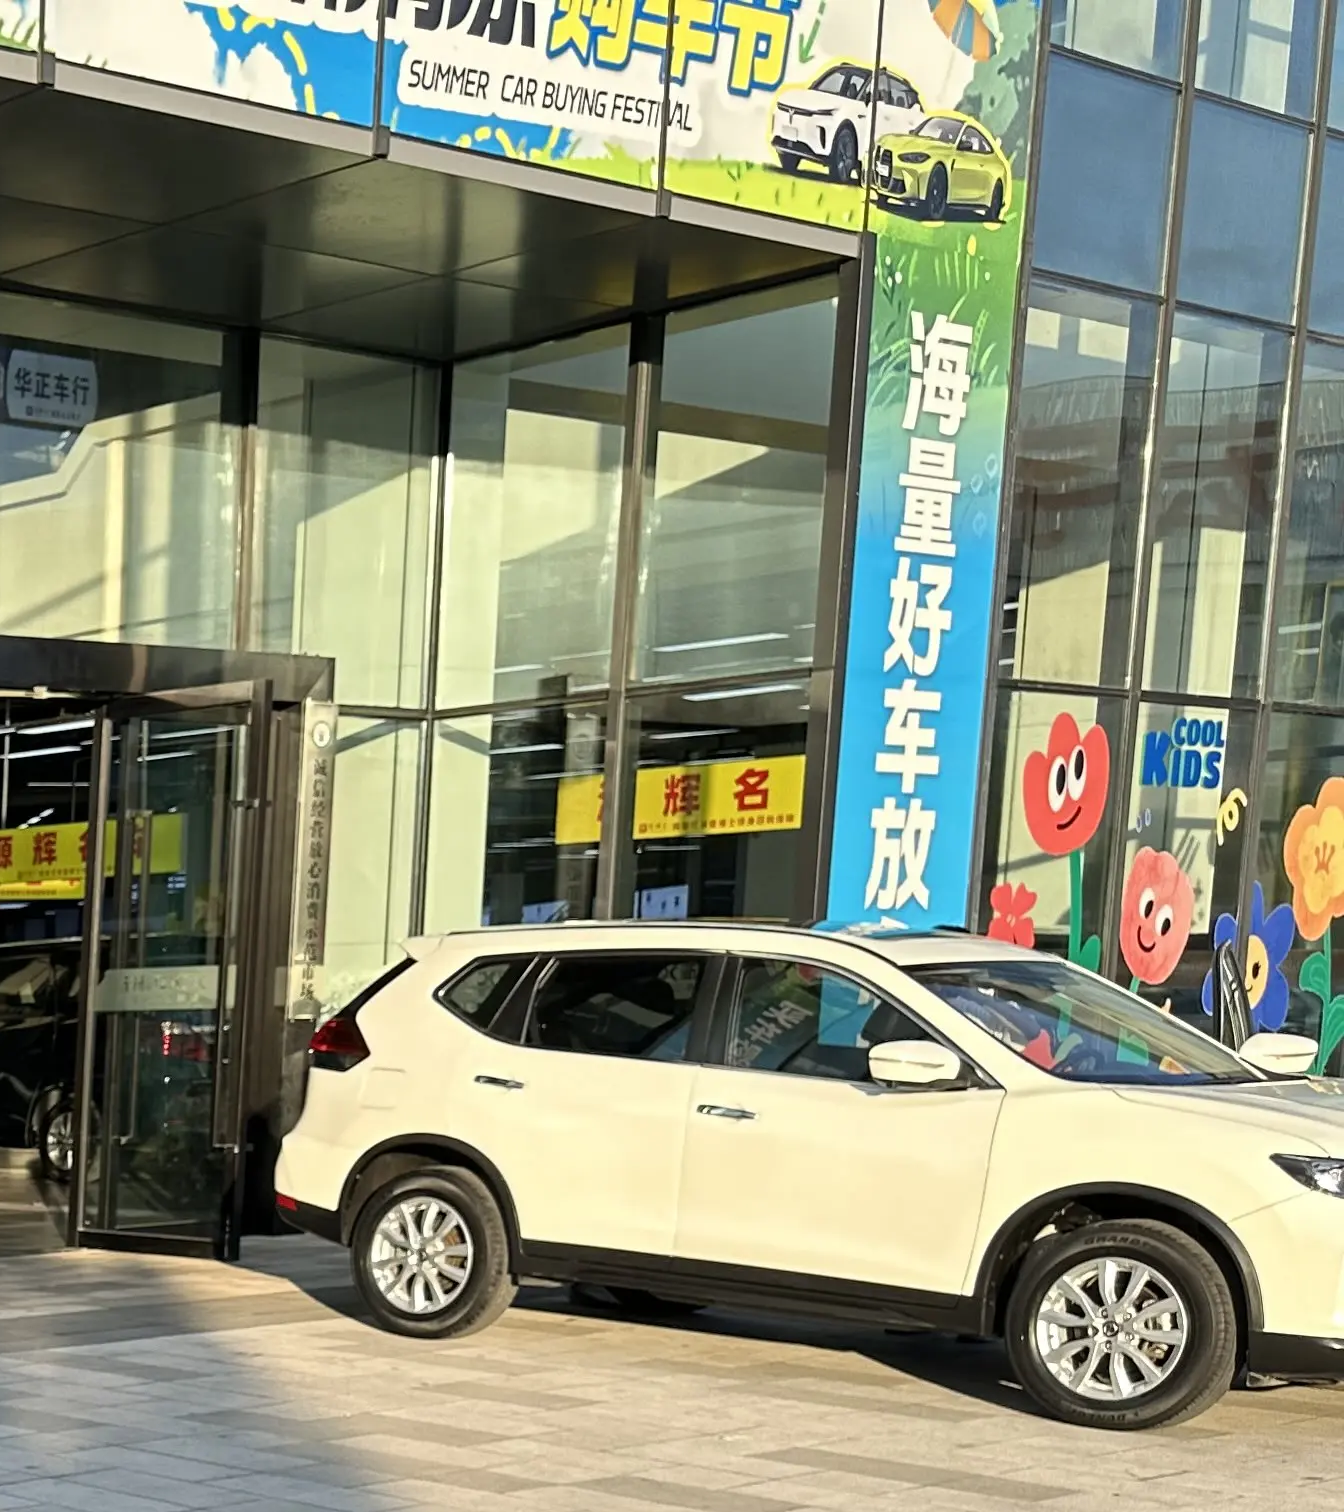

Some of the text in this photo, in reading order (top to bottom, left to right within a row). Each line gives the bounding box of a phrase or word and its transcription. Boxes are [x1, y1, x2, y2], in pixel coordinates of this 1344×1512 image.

[408, 59, 693, 132] SUMMER CAR BUYING FESTIVAL
[14, 367, 90, 406] 华正车行
[864, 311, 972, 928] 海量好车放
[1141, 730, 1222, 789] KIDS
[1173, 716, 1225, 749] COOL
